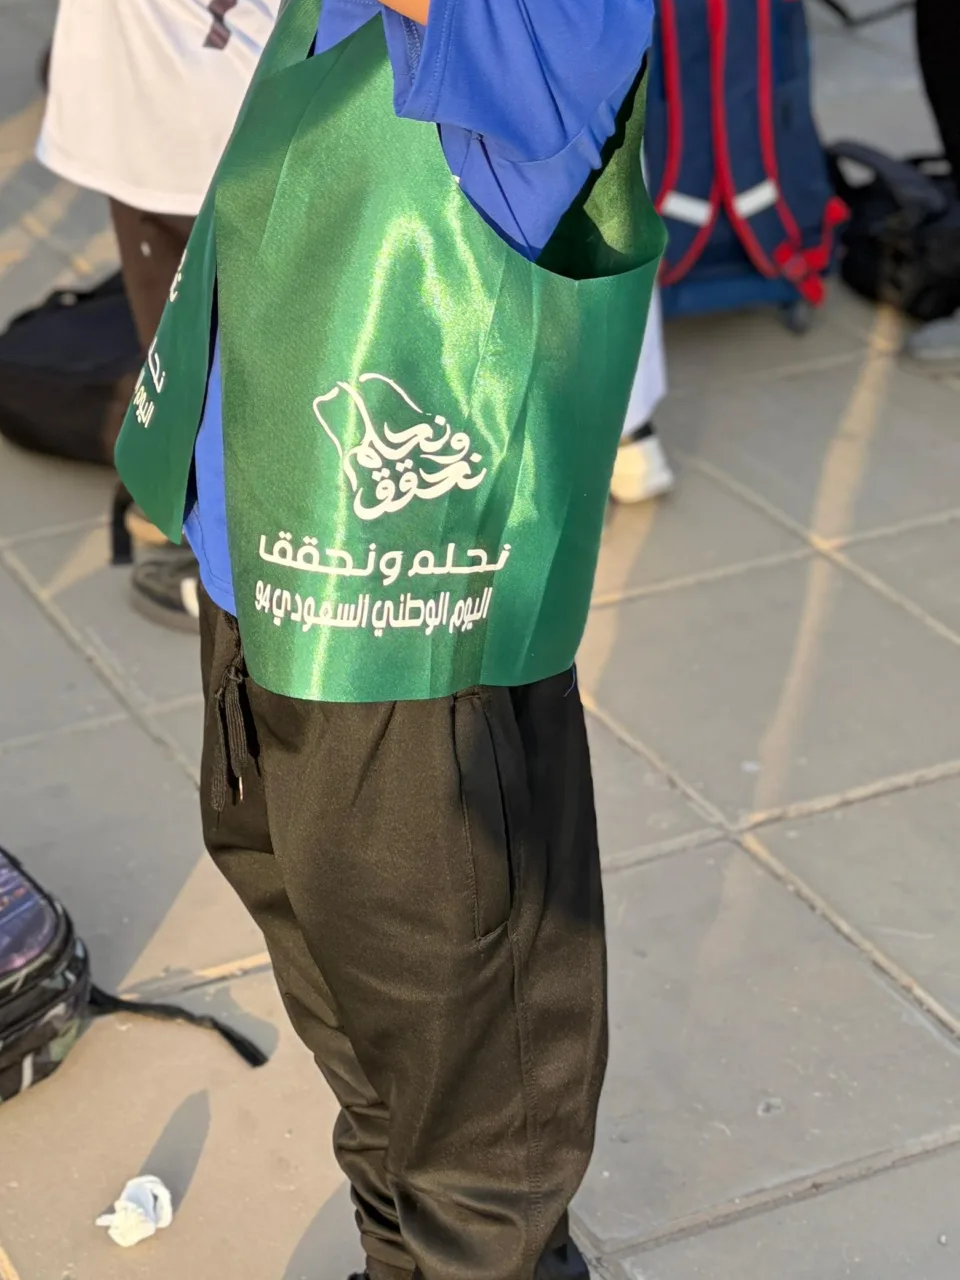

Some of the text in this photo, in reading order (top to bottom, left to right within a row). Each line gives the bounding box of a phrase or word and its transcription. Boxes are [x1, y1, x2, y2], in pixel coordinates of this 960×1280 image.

[257, 530, 513, 587] نحلم ونحقق
[253, 578, 494, 638] اليوم الوطني السعودي 94
